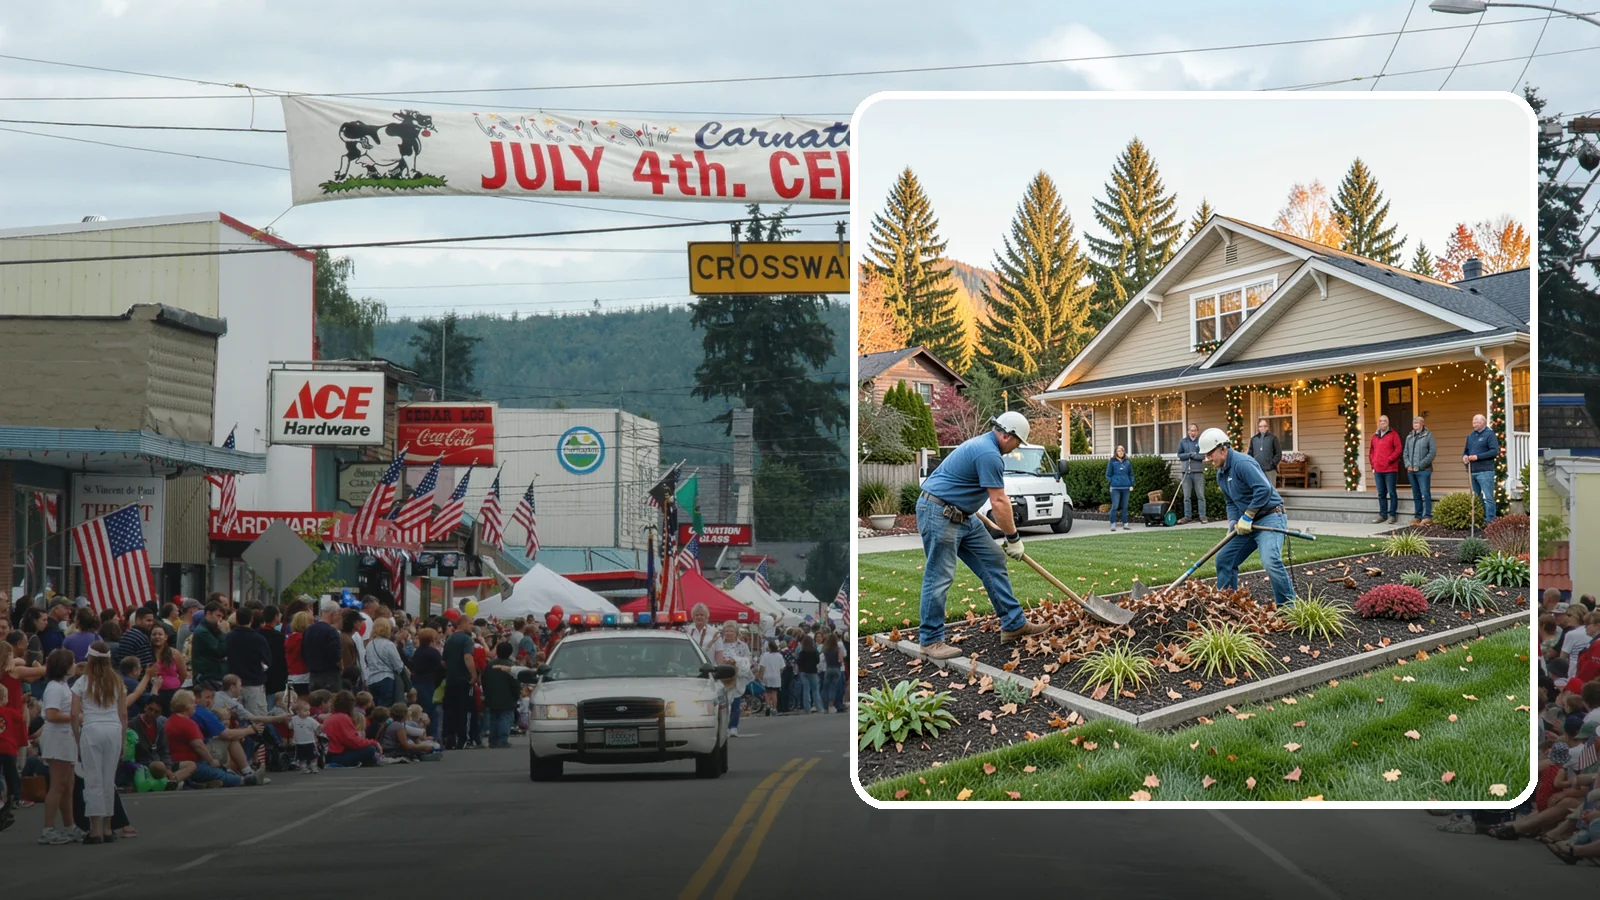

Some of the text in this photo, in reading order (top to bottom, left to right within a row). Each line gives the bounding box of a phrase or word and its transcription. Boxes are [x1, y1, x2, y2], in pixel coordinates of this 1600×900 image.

[481, 140, 604, 192] JULY
[632, 149, 746, 197] 4th.
[697, 254, 850, 280] CROSSWA
[282, 380, 373, 420] ACE
[405, 409, 452, 422] CEDAR
[283, 421, 370, 436] Hardware
[416, 428, 477, 447] Coca-Cola
[83, 485, 155, 496] St. Vincent de Paul
[212, 516, 331, 535] HARDARE
[688, 526, 741, 535] CRNATION
[699, 535, 730, 543] GLASS
